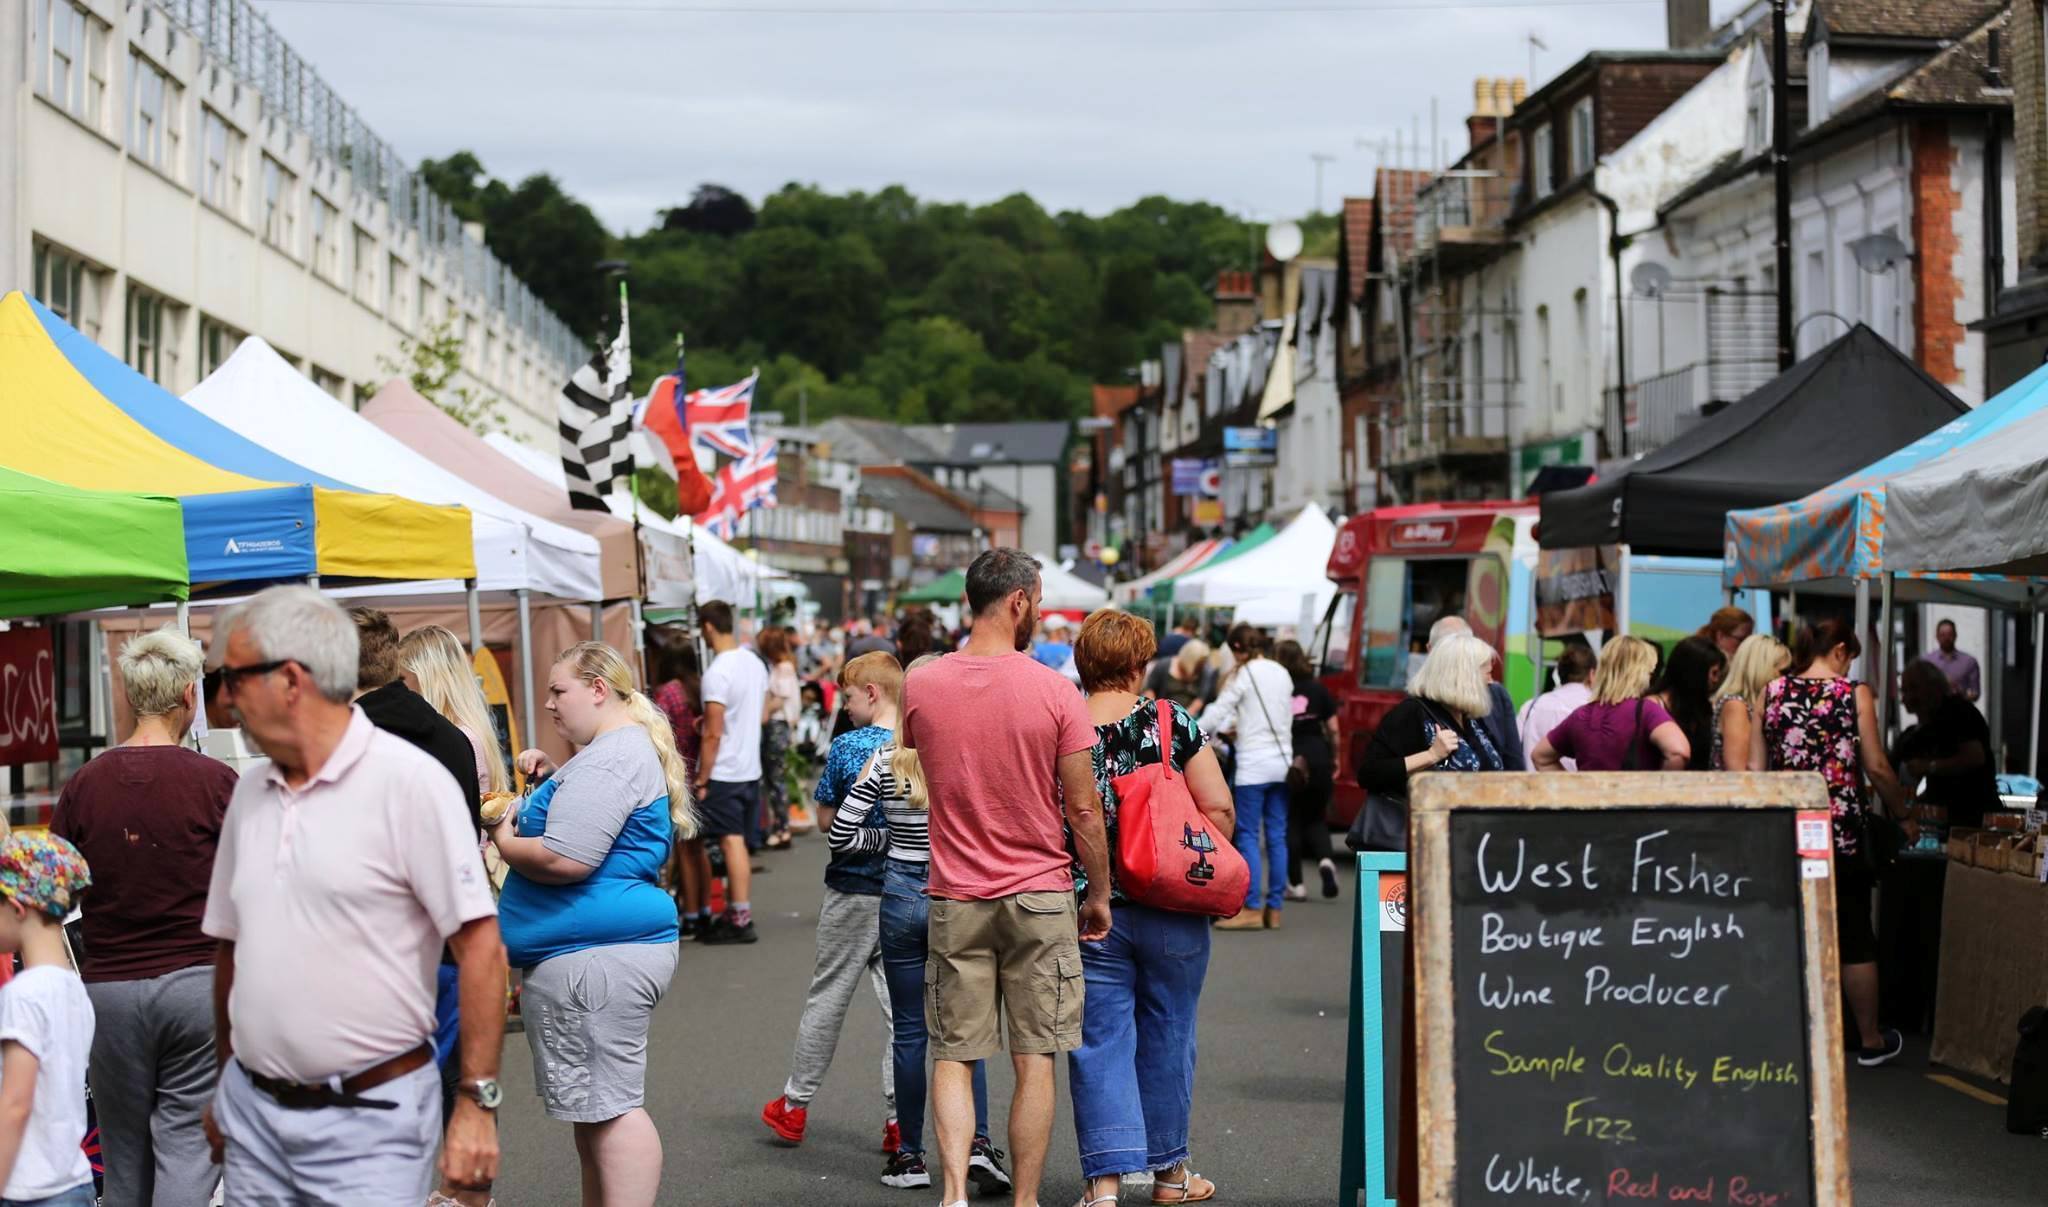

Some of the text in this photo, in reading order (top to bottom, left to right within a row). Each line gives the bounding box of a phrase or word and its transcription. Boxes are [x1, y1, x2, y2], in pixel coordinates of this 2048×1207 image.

[1477, 832, 1599, 893] West
[1631, 829, 1752, 897] Fisher
[1481, 912, 1744, 960] Boutique English
[1478, 965, 1730, 1009] Wine Producer
[1483, 1029, 1799, 1092] Sample Quality English
[1484, 1153, 1591, 1201] White,
[1607, 1167, 1660, 1198] Red
[1668, 1175, 1713, 1201] and
